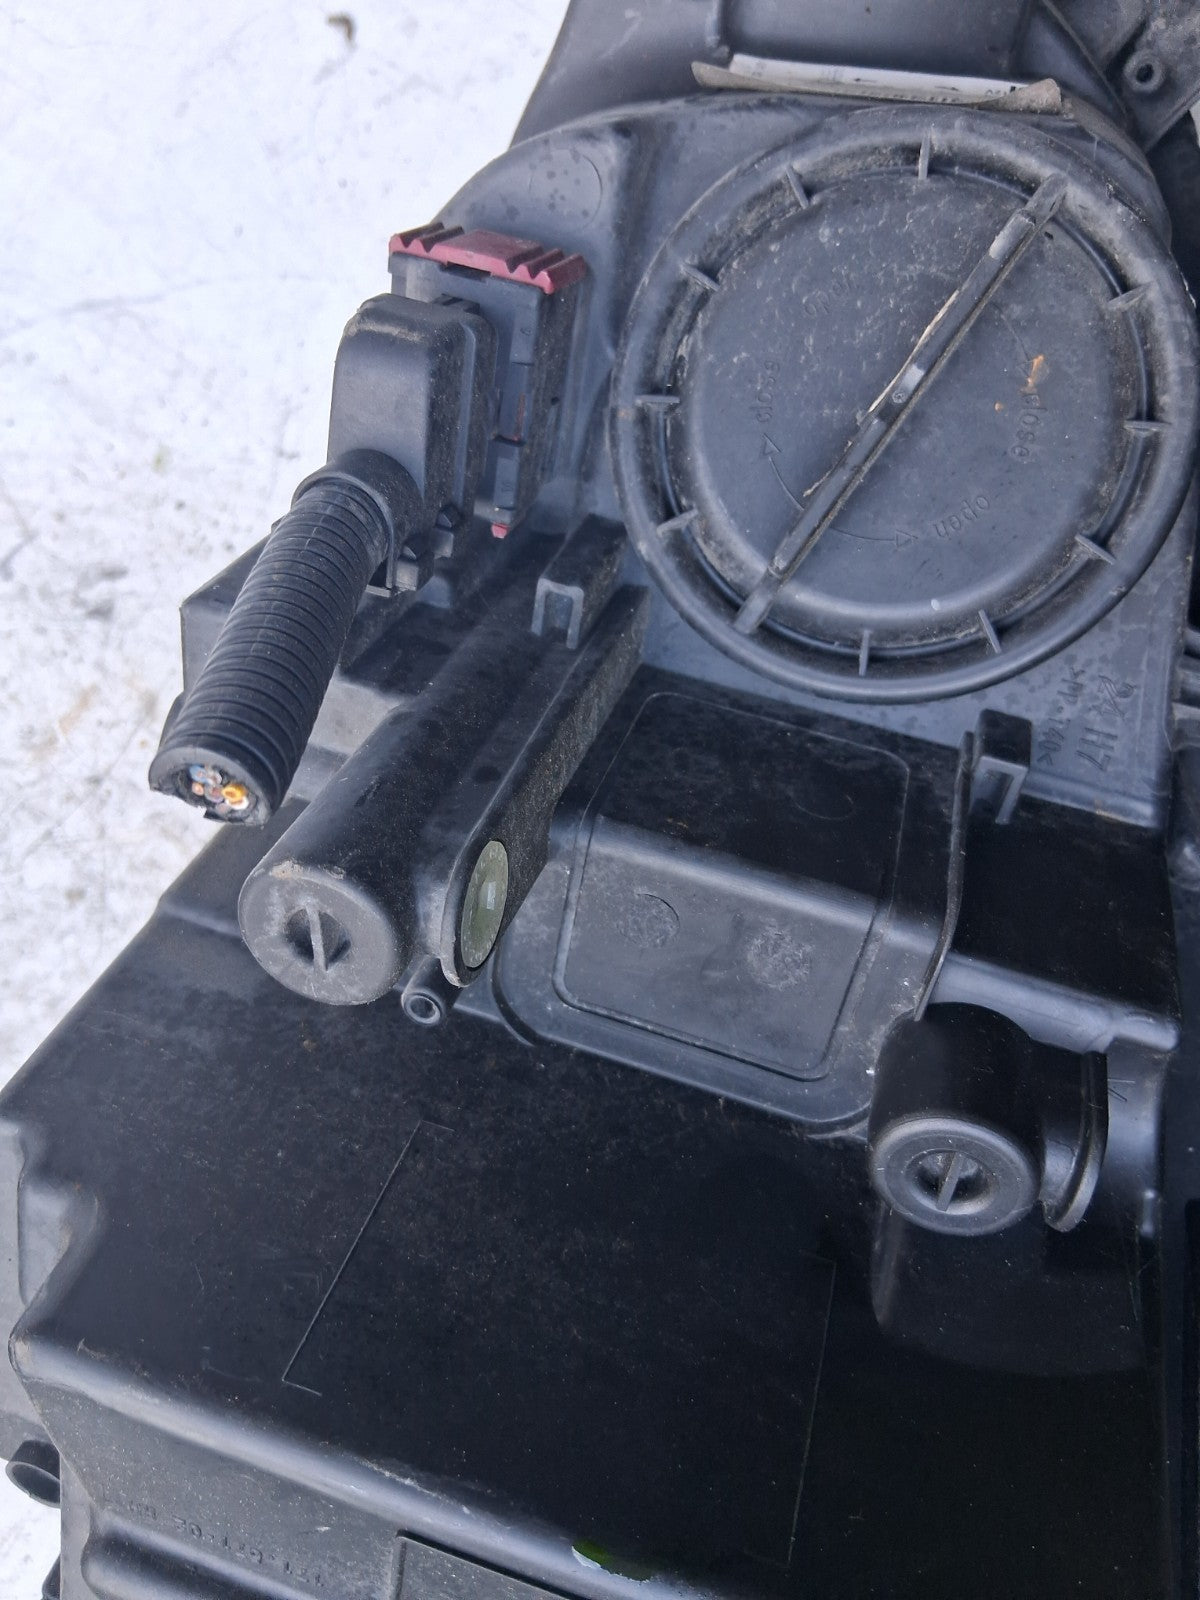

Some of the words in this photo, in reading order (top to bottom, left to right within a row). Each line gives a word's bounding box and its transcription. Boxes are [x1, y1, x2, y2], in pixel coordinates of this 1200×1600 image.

[750, 360, 780, 423] close
[1011, 393, 1048, 457] close
[933, 496, 990, 538] open
[1075, 726, 1118, 772] H7
